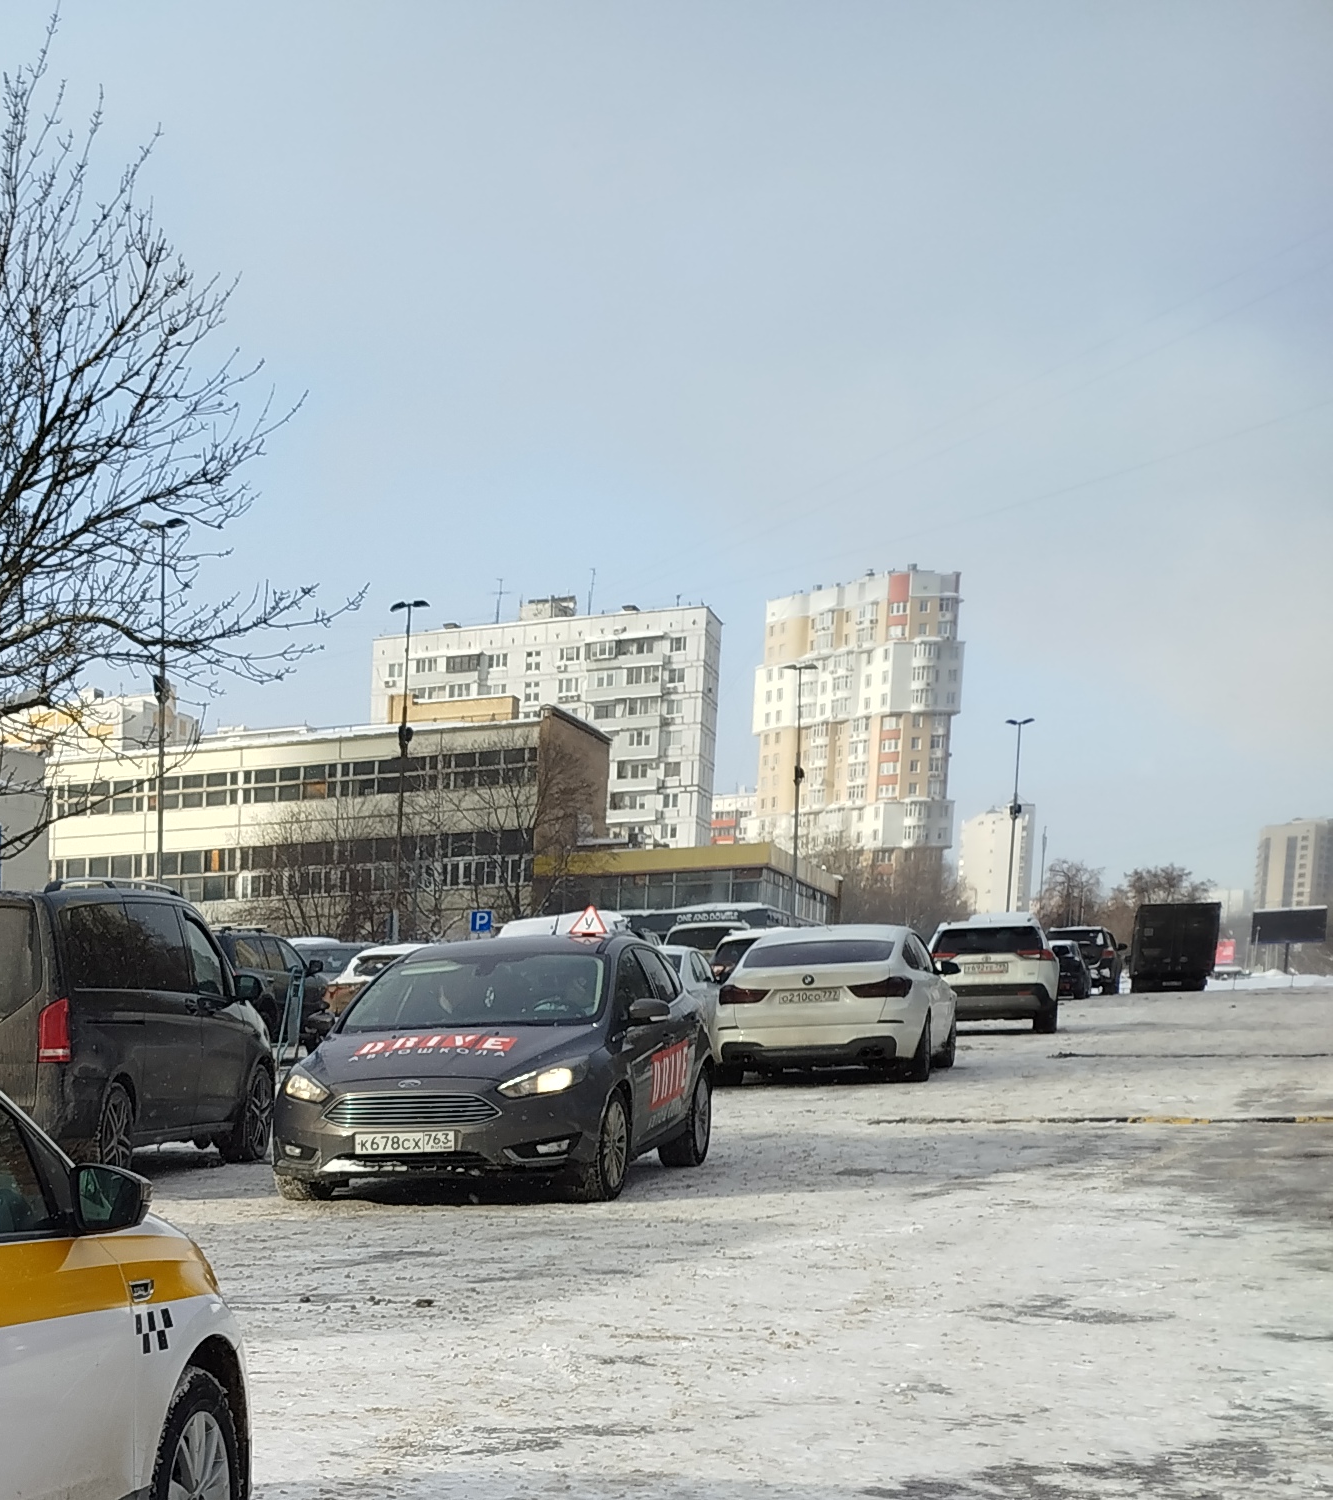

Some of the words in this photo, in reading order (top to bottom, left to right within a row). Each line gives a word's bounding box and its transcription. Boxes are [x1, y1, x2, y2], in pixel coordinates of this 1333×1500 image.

[475, 912, 489, 930] P
[359, 1035, 511, 1054] DRIVE
[348, 1047, 506, 1062] АВТОШКОЛА
[652, 1045, 688, 1105] DRIVE
[360, 1135, 422, 1151] К678СХ
[425, 1132, 450, 1146] 763
